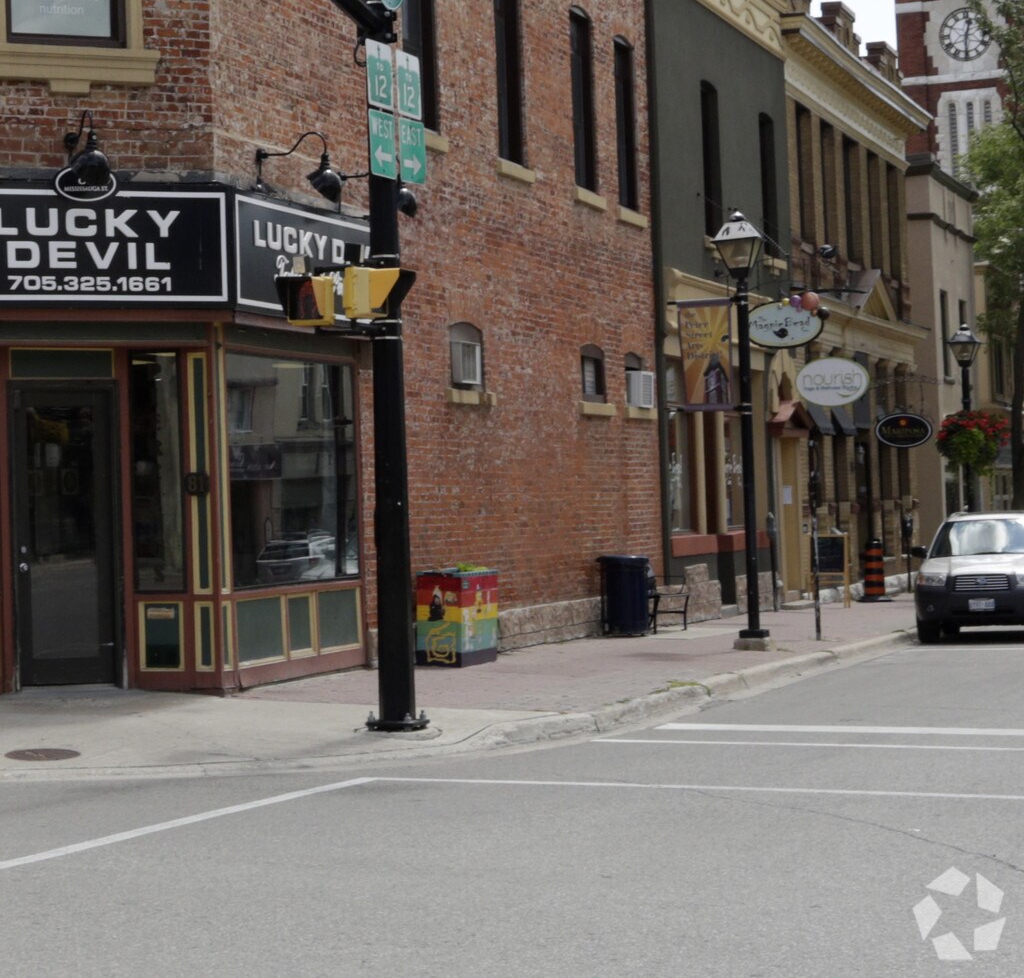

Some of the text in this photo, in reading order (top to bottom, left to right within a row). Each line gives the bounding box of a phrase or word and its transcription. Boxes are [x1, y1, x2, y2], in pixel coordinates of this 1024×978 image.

[39, 3, 85, 15] nutrition
[374, 74, 388, 99] 12
[403, 83, 416, 109] 12
[372, 115, 393, 140] WEST
[401, 124, 422, 147] EAST
[253, 219, 328, 260] LUCKY
[6, 240, 171, 270] DEVIL
[7, 275, 172, 292] 705.325.1661
[803, 369, 863, 385] nourish
